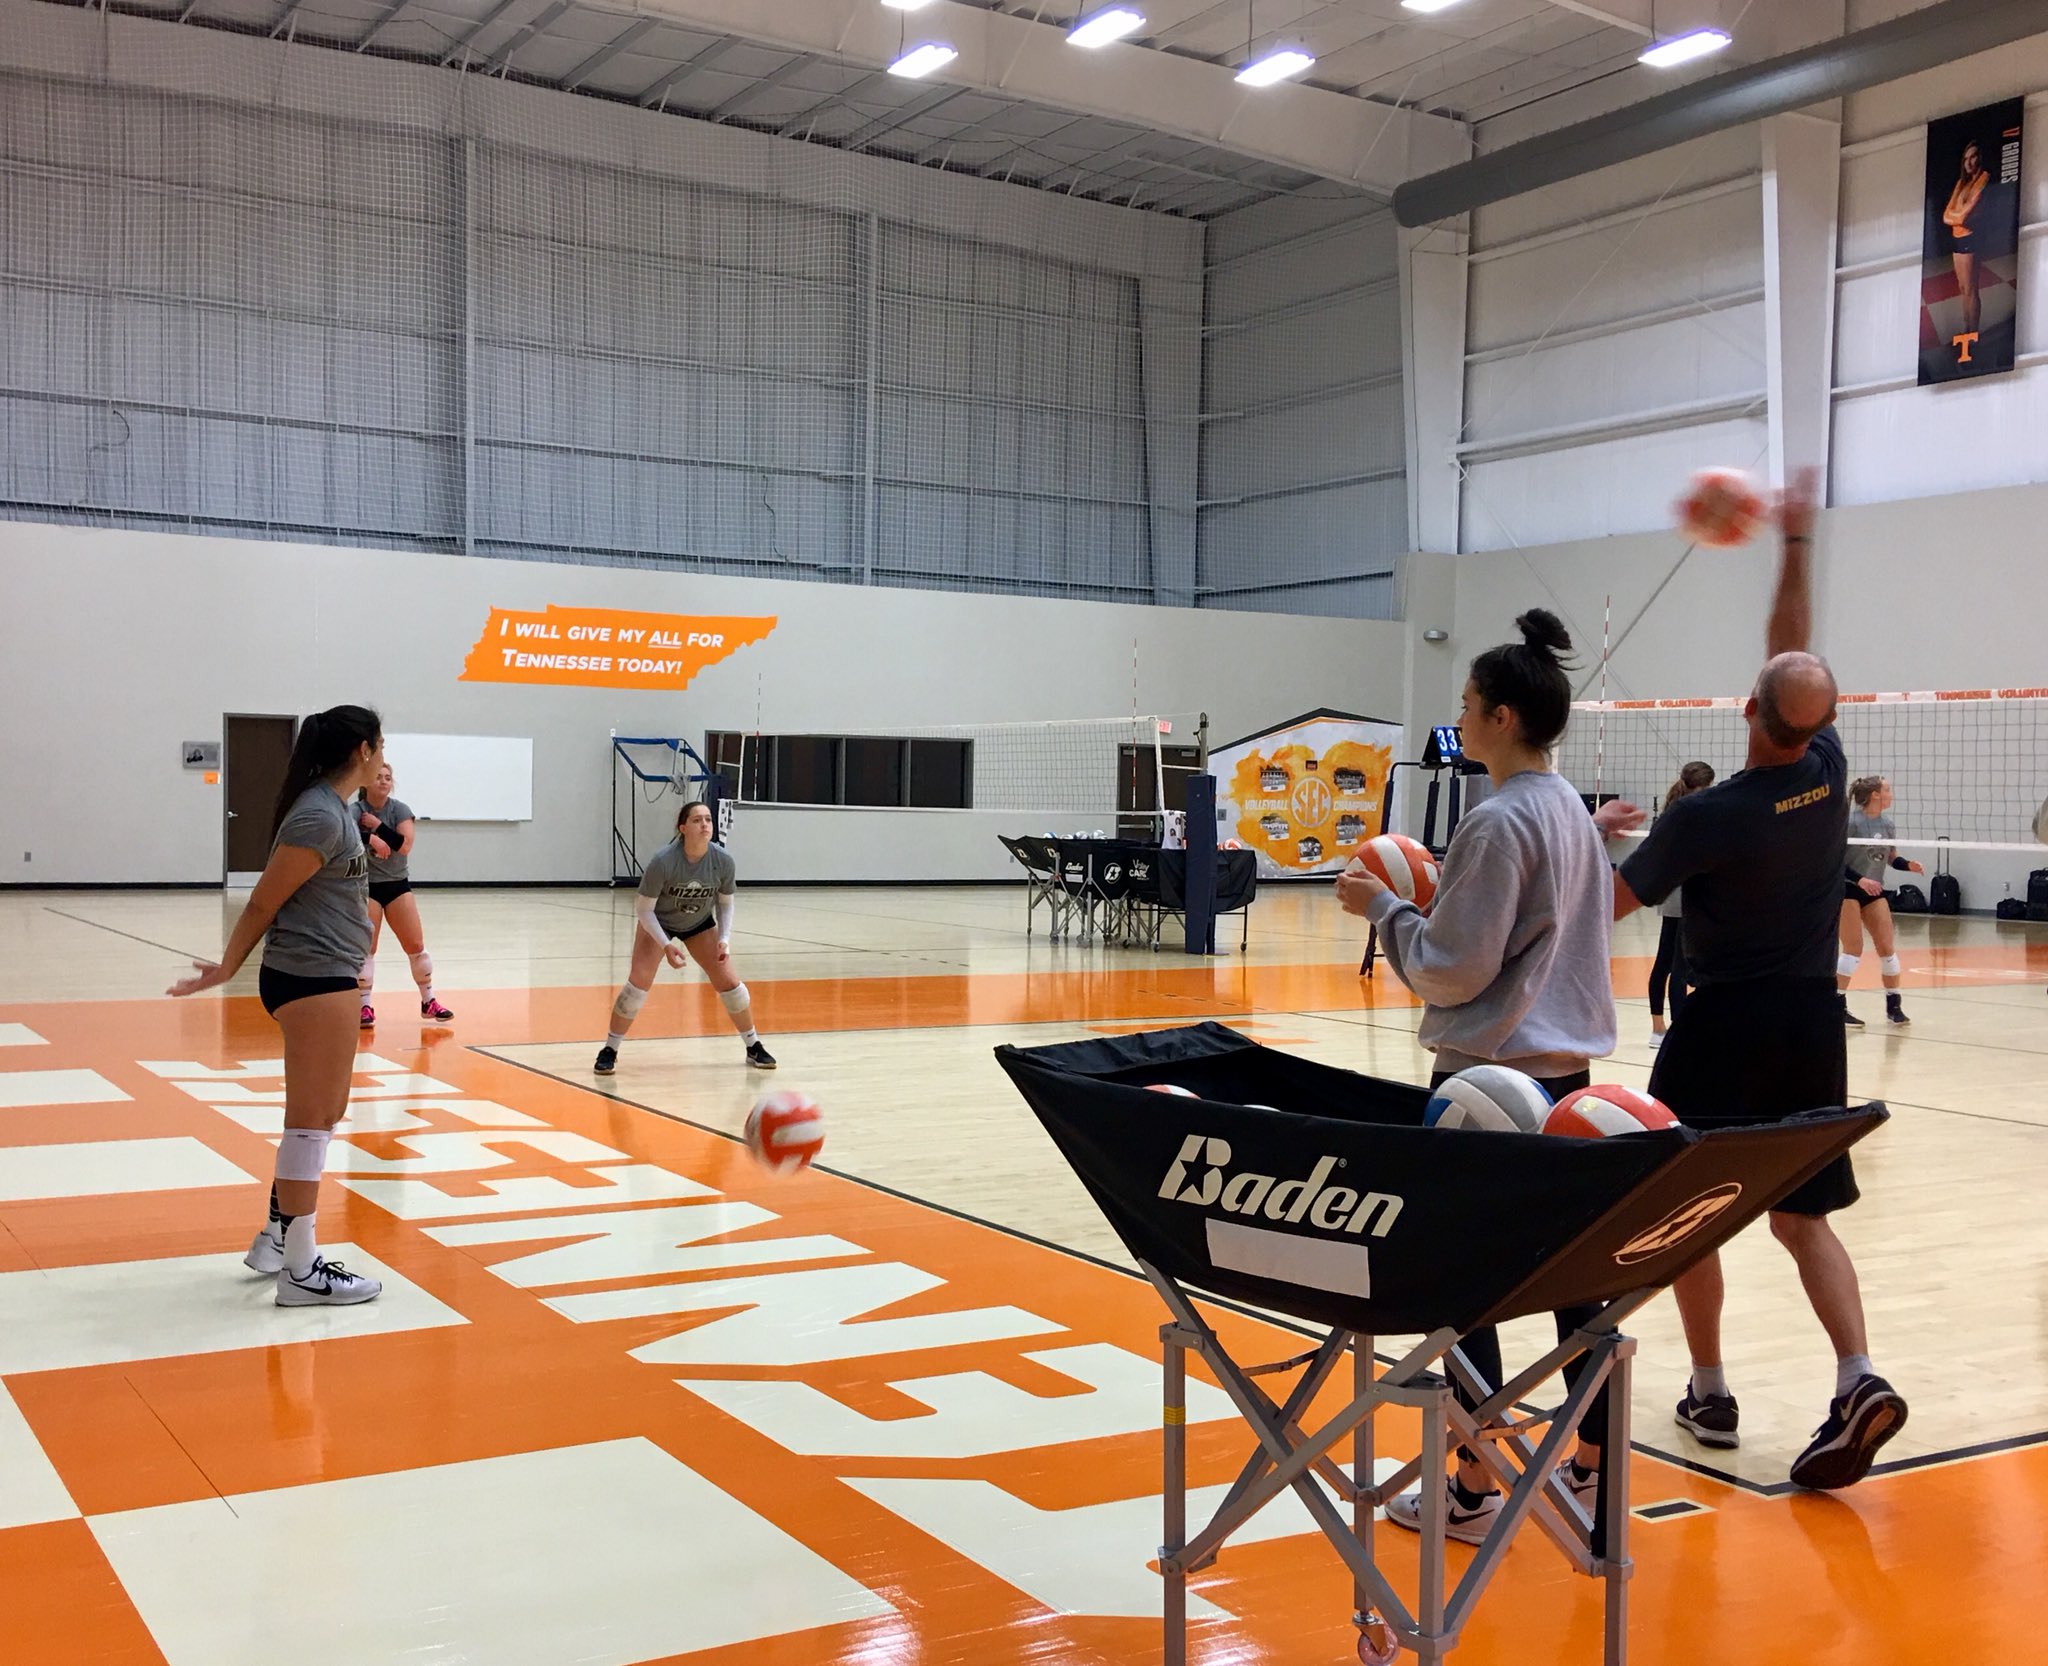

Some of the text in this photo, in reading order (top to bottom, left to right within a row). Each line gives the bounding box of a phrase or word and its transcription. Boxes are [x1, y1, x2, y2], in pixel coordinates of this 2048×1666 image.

[1952, 331, 1979, 364] T
[500, 618, 724, 648] I WILL GIVE MY ALL FOR
[502, 648, 682, 674] TENNESSEE TODAY!
[1437, 729, 1458, 751] 33
[1244, 799, 1289, 811] VOLLEYBALL
[1775, 784, 1830, 814] MIZZOU
[1158, 1134, 1404, 1238] Baden
